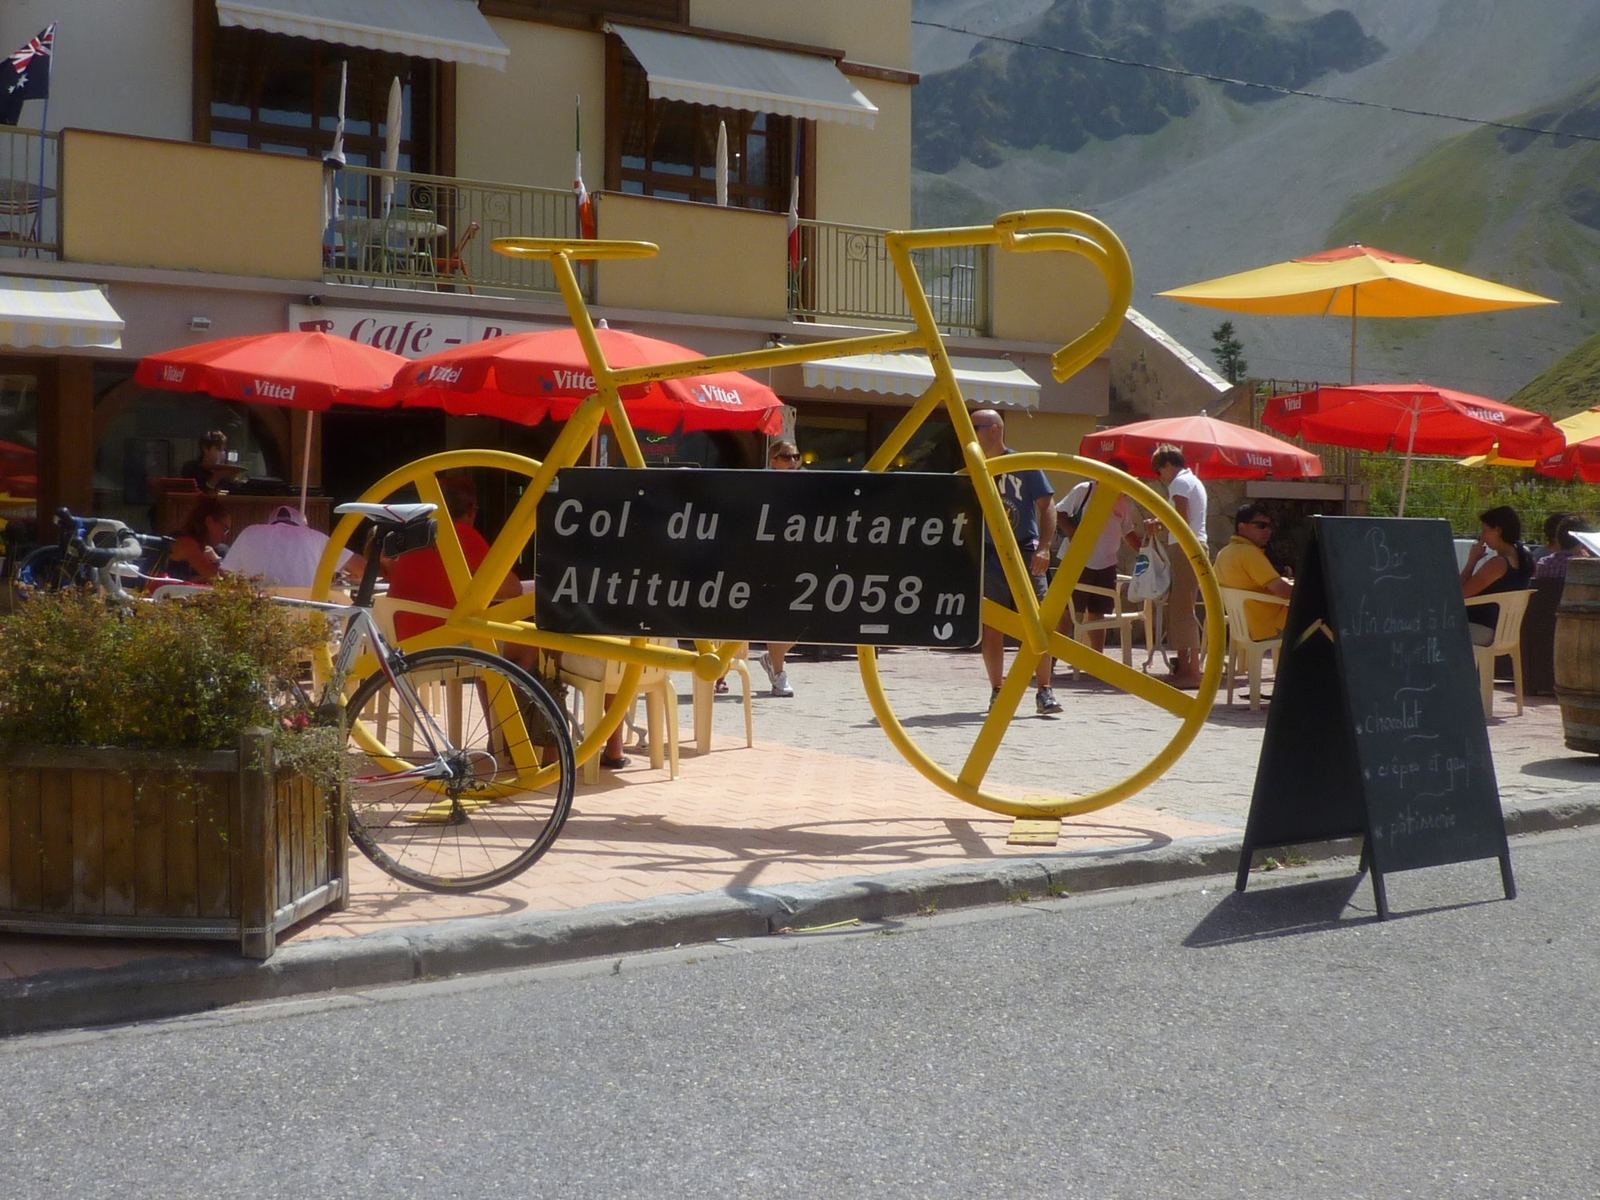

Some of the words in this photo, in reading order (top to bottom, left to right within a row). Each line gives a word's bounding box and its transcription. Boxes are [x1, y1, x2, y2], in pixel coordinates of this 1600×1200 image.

[348, 317, 433, 356] Café
[163, 364, 186, 384] Vittel
[427, 365, 463, 384] Vittel
[552, 370, 599, 390] Vitte
[253, 380, 297, 401] Vittel
[700, 384, 743, 405] Vittel
[1472, 407, 1505, 422] Vittel
[1245, 452, 1272, 468] Vittel
[554, 499, 630, 538] Col
[667, 503, 719, 540] du
[756, 504, 969, 546] Lautaret
[552, 566, 751, 609] Altitude
[789, 573, 923, 615] 2058
[935, 590, 966, 615] m
